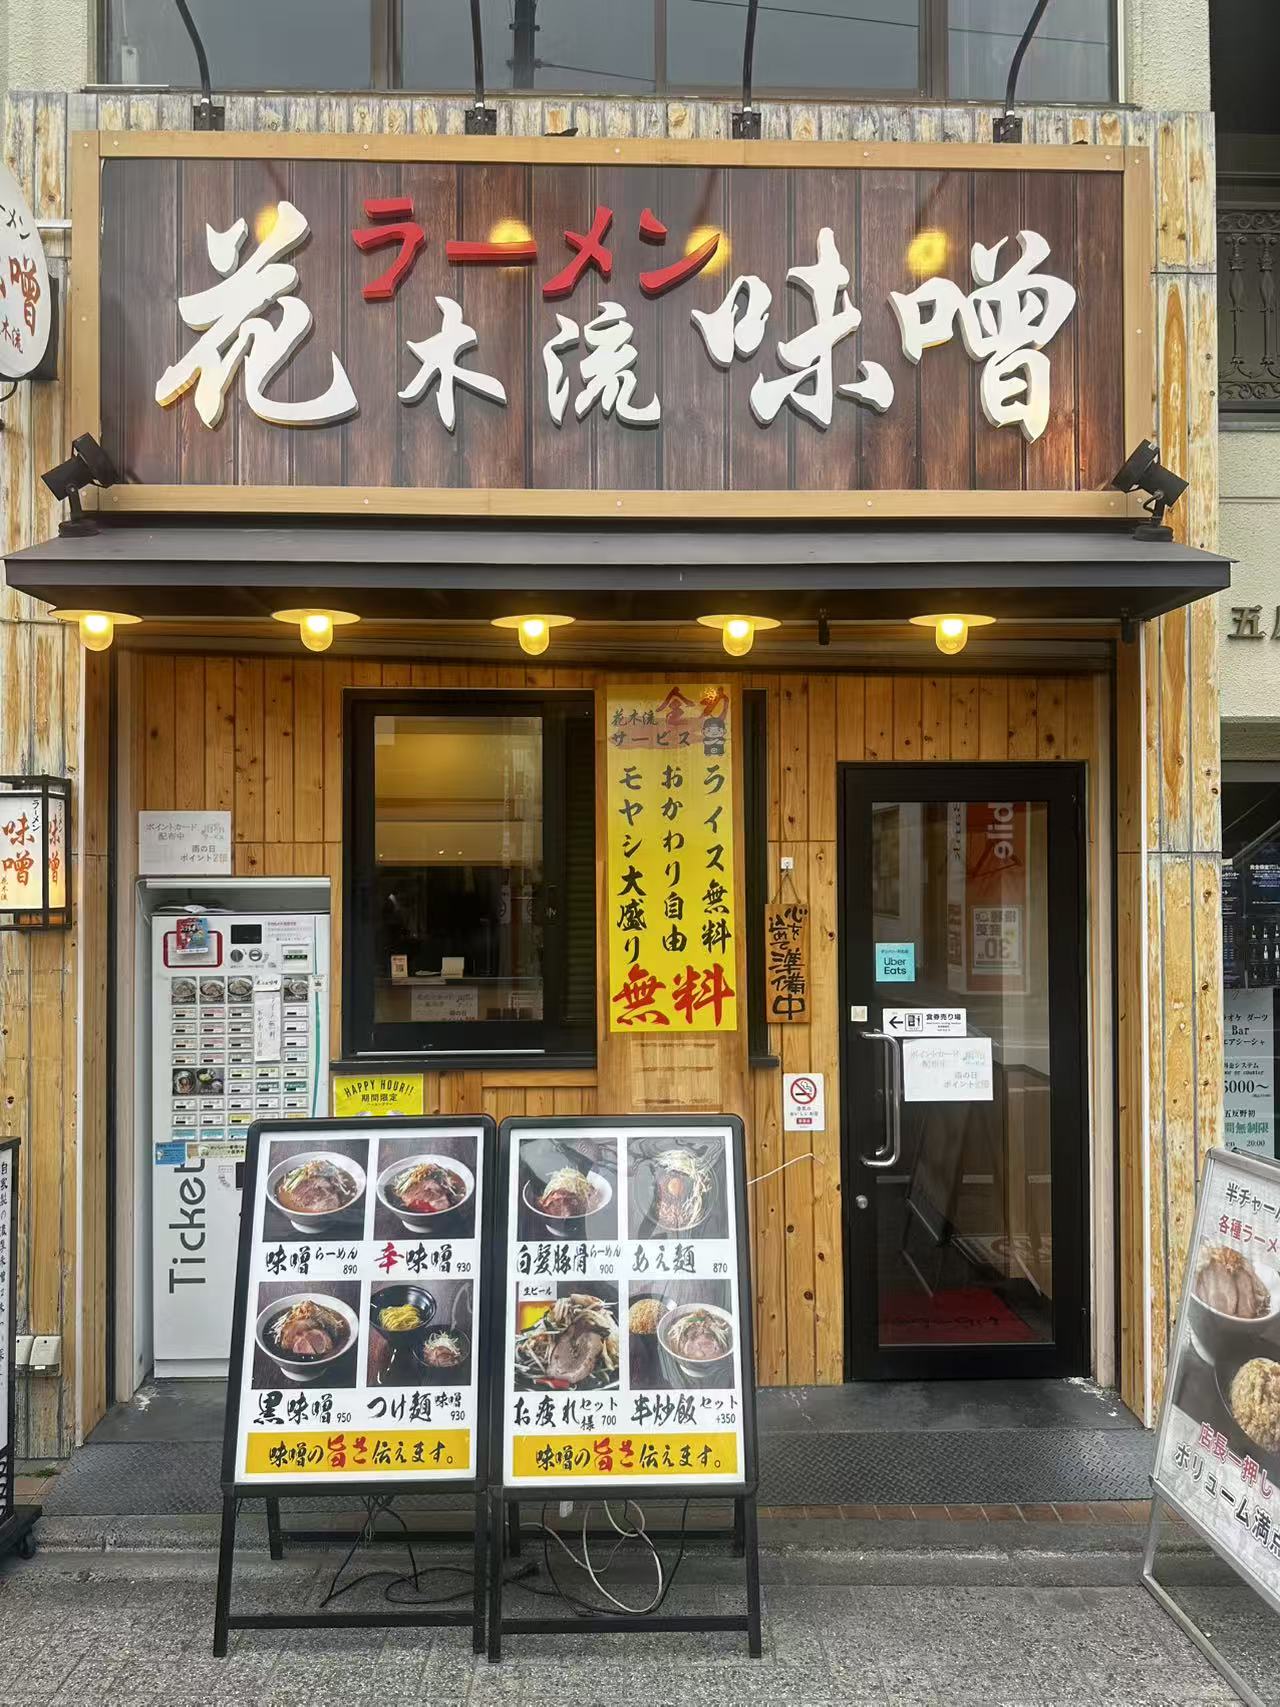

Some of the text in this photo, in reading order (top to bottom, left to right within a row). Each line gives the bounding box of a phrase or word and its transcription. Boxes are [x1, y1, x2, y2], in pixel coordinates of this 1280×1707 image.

[352, 196, 721, 301] ラーメン
[1227, 604, 1280, 640] 五
[611, 730, 691, 746] サービス
[32, 799, 41, 832] ラーメン
[1, 812, 36, 886] 味噌
[616, 765, 648, 965] モヤシ大盛り
[660, 764, 688, 953] おかわり自由
[701, 764, 732, 954] ライス無料
[884, 957, 906, 966] Uber
[884, 966, 907, 975] Eats
[768, 948, 805, 1020] 準備中
[612, 963, 736, 1027] 無料
[926, 1013, 961, 1021] 食券売り場
[1231, 1025, 1250, 1036] Bar
[344, 1079, 414, 1098] HAPPY HOUR!!
[169, 1158, 206, 1294] Ticket
[343, 1264, 358, 1275] 890
[456, 1263, 471, 1273] 930
[599, 1264, 614, 1275] 900
[712, 1263, 728, 1273] 870
[253, 1390, 332, 1425] 黒味噌
[450, 1410, 465, 1421] 930
[336, 1412, 351, 1423] 950
[601, 1415, 617, 1426] 700
